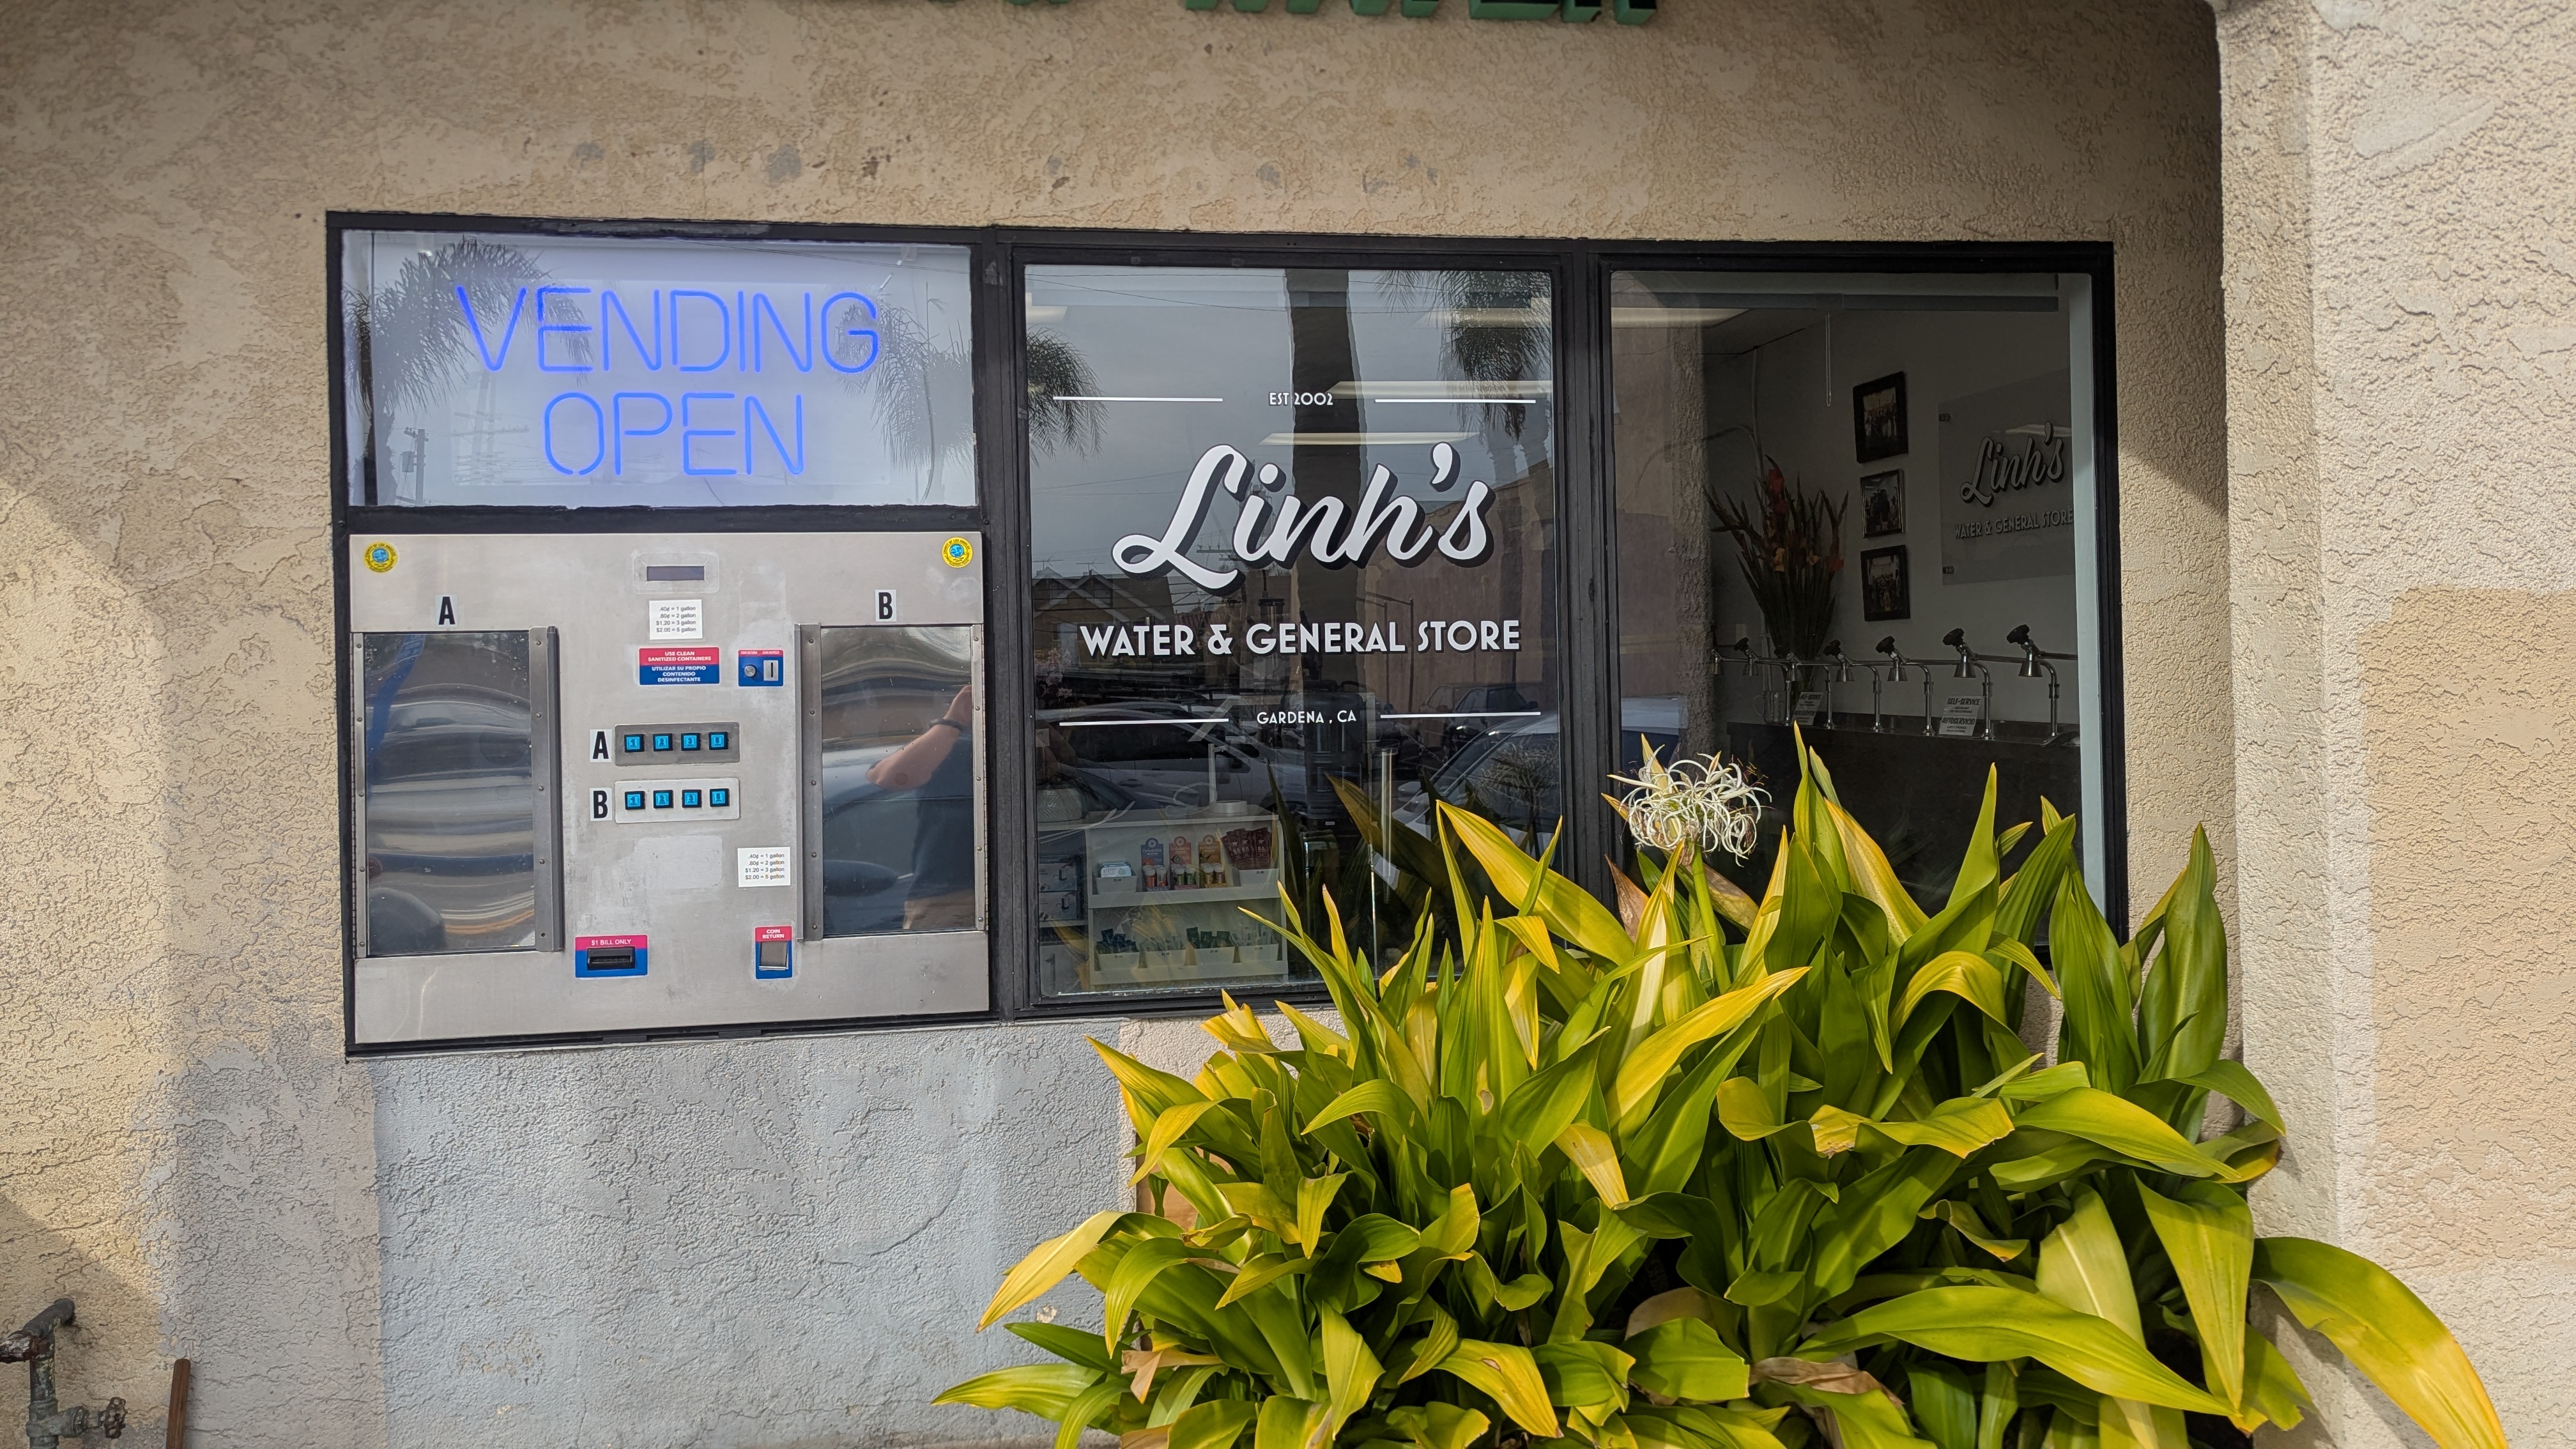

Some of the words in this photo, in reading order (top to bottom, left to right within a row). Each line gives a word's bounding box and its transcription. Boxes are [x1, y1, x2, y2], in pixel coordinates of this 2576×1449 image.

[456, 284, 879, 374] VENDING
[1269, 392, 1290, 406] EST
[1294, 392, 1334, 406] 2002
[543, 392, 803, 477] OPEN
[1960, 420, 2065, 508] Linh's
[1112, 441, 1495, 594] Linh's
[1953, 521, 1982, 540] WATER
[1984, 520, 1993, 535] &
[1995, 512, 2041, 534] GENERAL
[2042, 506, 2074, 528] STORE
[438, 596, 456, 625] A
[878, 592, 893, 620] B
[1080, 624, 1197, 656] WATER
[1207, 624, 1234, 656] &
[1246, 620, 1407, 654] GENERAL
[1418, 620, 1521, 654] STORE
[1256, 710, 1324, 724] GARDENA
[1337, 710, 1357, 723] CA
[1942, 717, 1975, 725] AUTOSERVICIO
[592, 731, 609, 760] A
[593, 790, 609, 819] B
